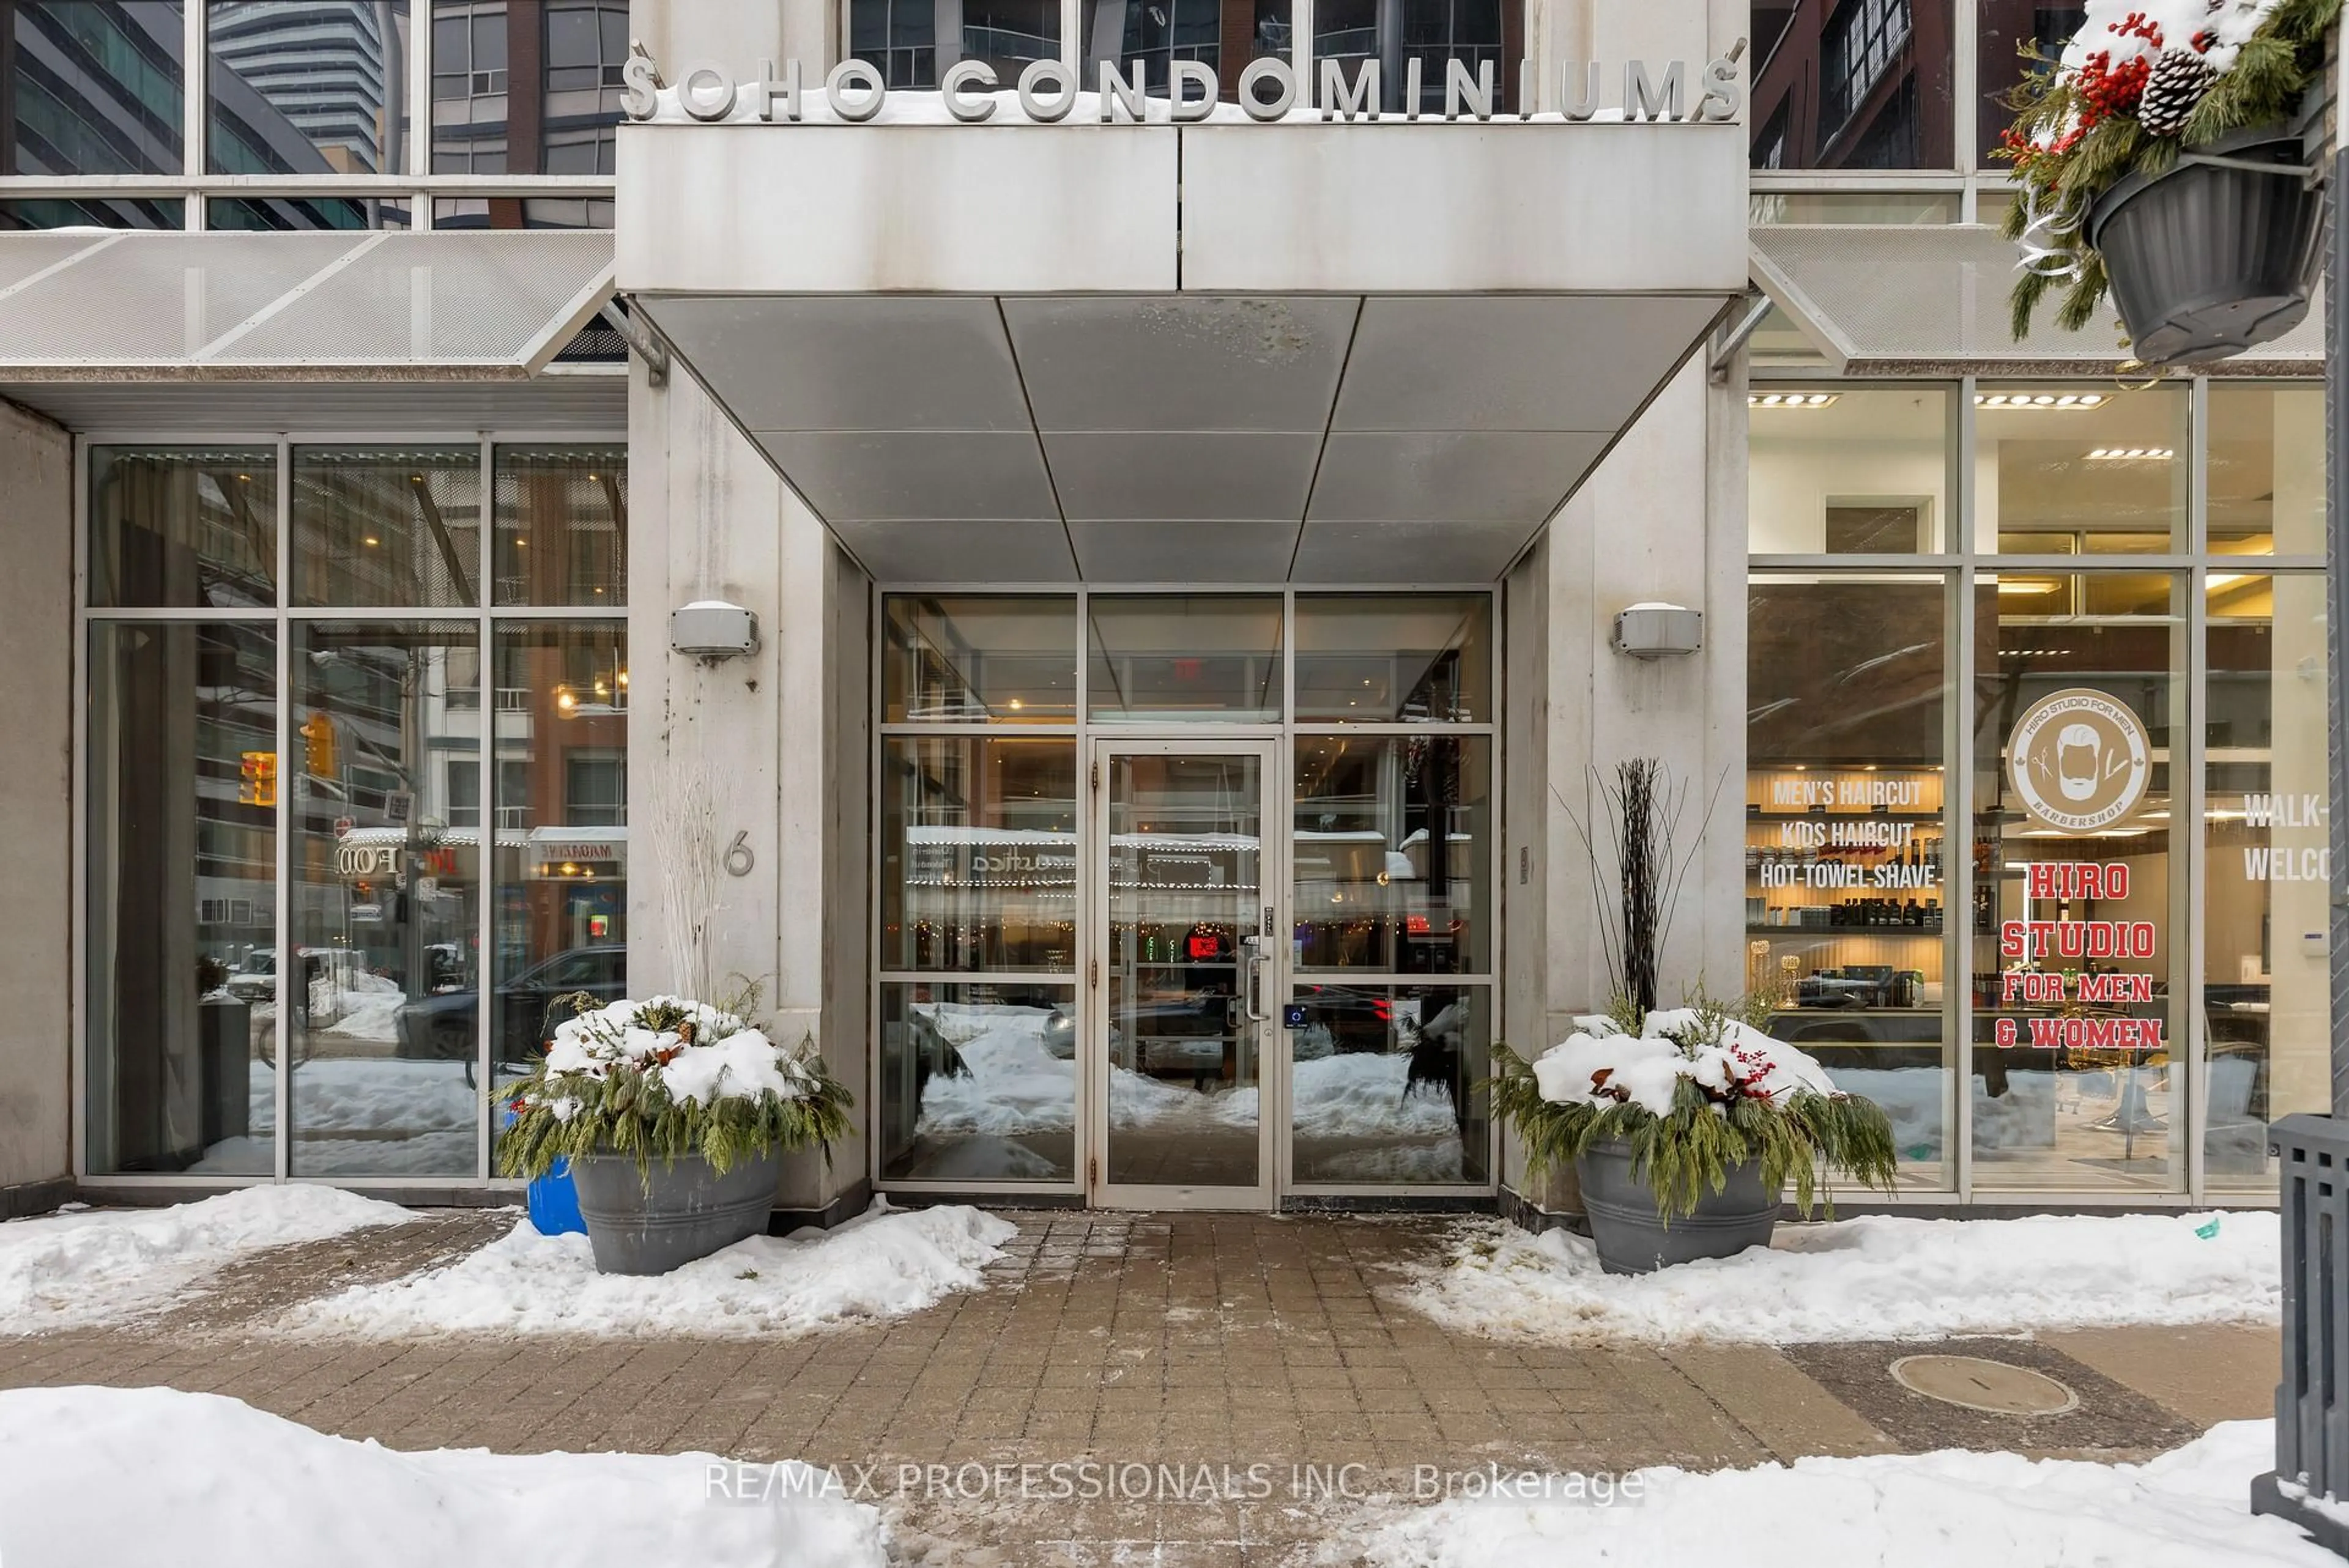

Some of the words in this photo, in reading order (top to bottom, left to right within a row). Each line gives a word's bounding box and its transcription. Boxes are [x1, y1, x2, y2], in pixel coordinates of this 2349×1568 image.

[619, 55, 885, 122] SOHO
[942, 56, 1743, 122] CONDOMINIUMS
[2025, 709, 2049, 735] HIRO
[2050, 698, 2089, 714] STUDIO
[2090, 701, 2113, 716] FOR
[2112, 711, 2136, 736] MEN
[1840, 781, 1922, 805] HAIRCUT
[2033, 801, 2123, 827] BARBERSHOP
[1781, 823, 1826, 847] KIDS
[1831, 823, 1915, 847] HAIRCUT
[723, 830, 754, 877] 6
[1761, 864, 1798, 887] HOT
[1803, 864, 1868, 887] TOWEL
[1874, 864, 1935, 887] SHAVE
[2029, 862, 2129, 900] HIRO
[2002, 921, 2155, 958] STUDIO
[2003, 974, 2065, 1002] FOR
[2077, 974, 2153, 1002] MEN
[1995, 1018, 2017, 1048] &
[2028, 1018, 2162, 1048] WOMEN
